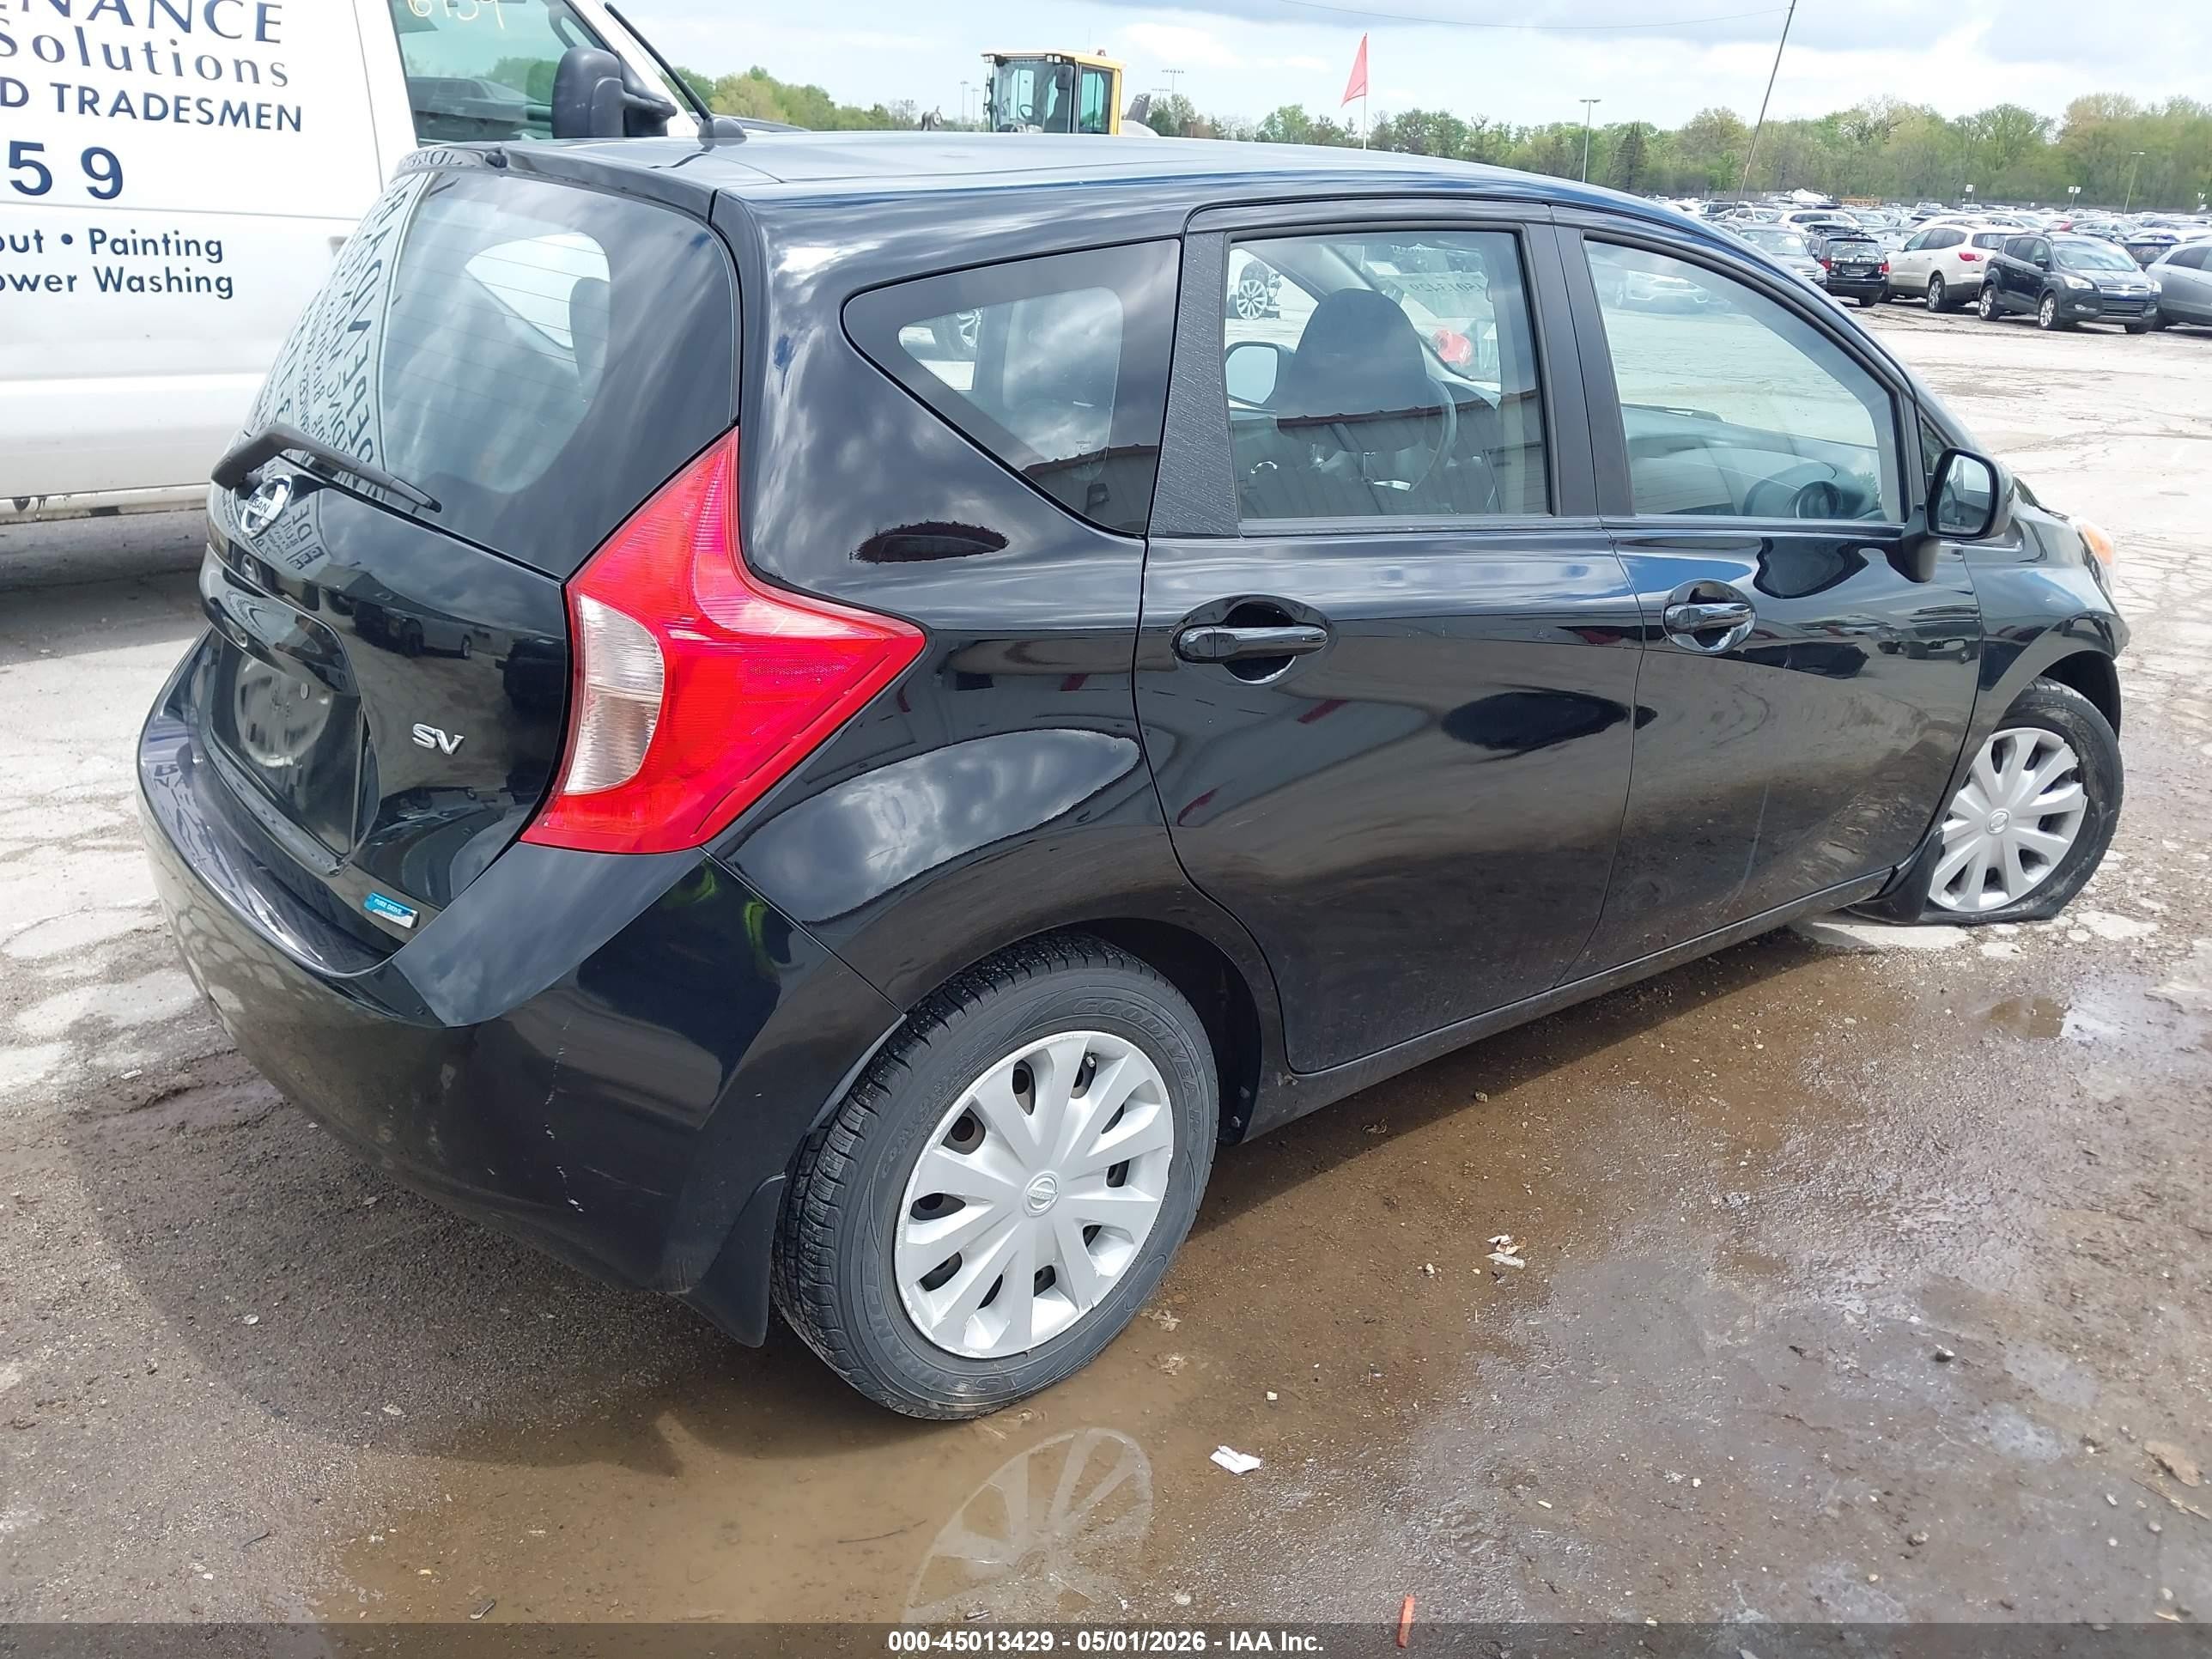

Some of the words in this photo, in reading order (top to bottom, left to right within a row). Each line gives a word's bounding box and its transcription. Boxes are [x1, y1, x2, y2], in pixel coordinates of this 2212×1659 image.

[0, 0, 282, 43] ANCE
[0, 17, 289, 88] Solutions
[50, 82, 301, 132] TRADESMEN
[88, 228, 223, 264] Painting
[93, 265, 234, 300] Washing
[412, 724, 465, 755] SV
[1073, 999, 1201, 1135] GOODYEAR
